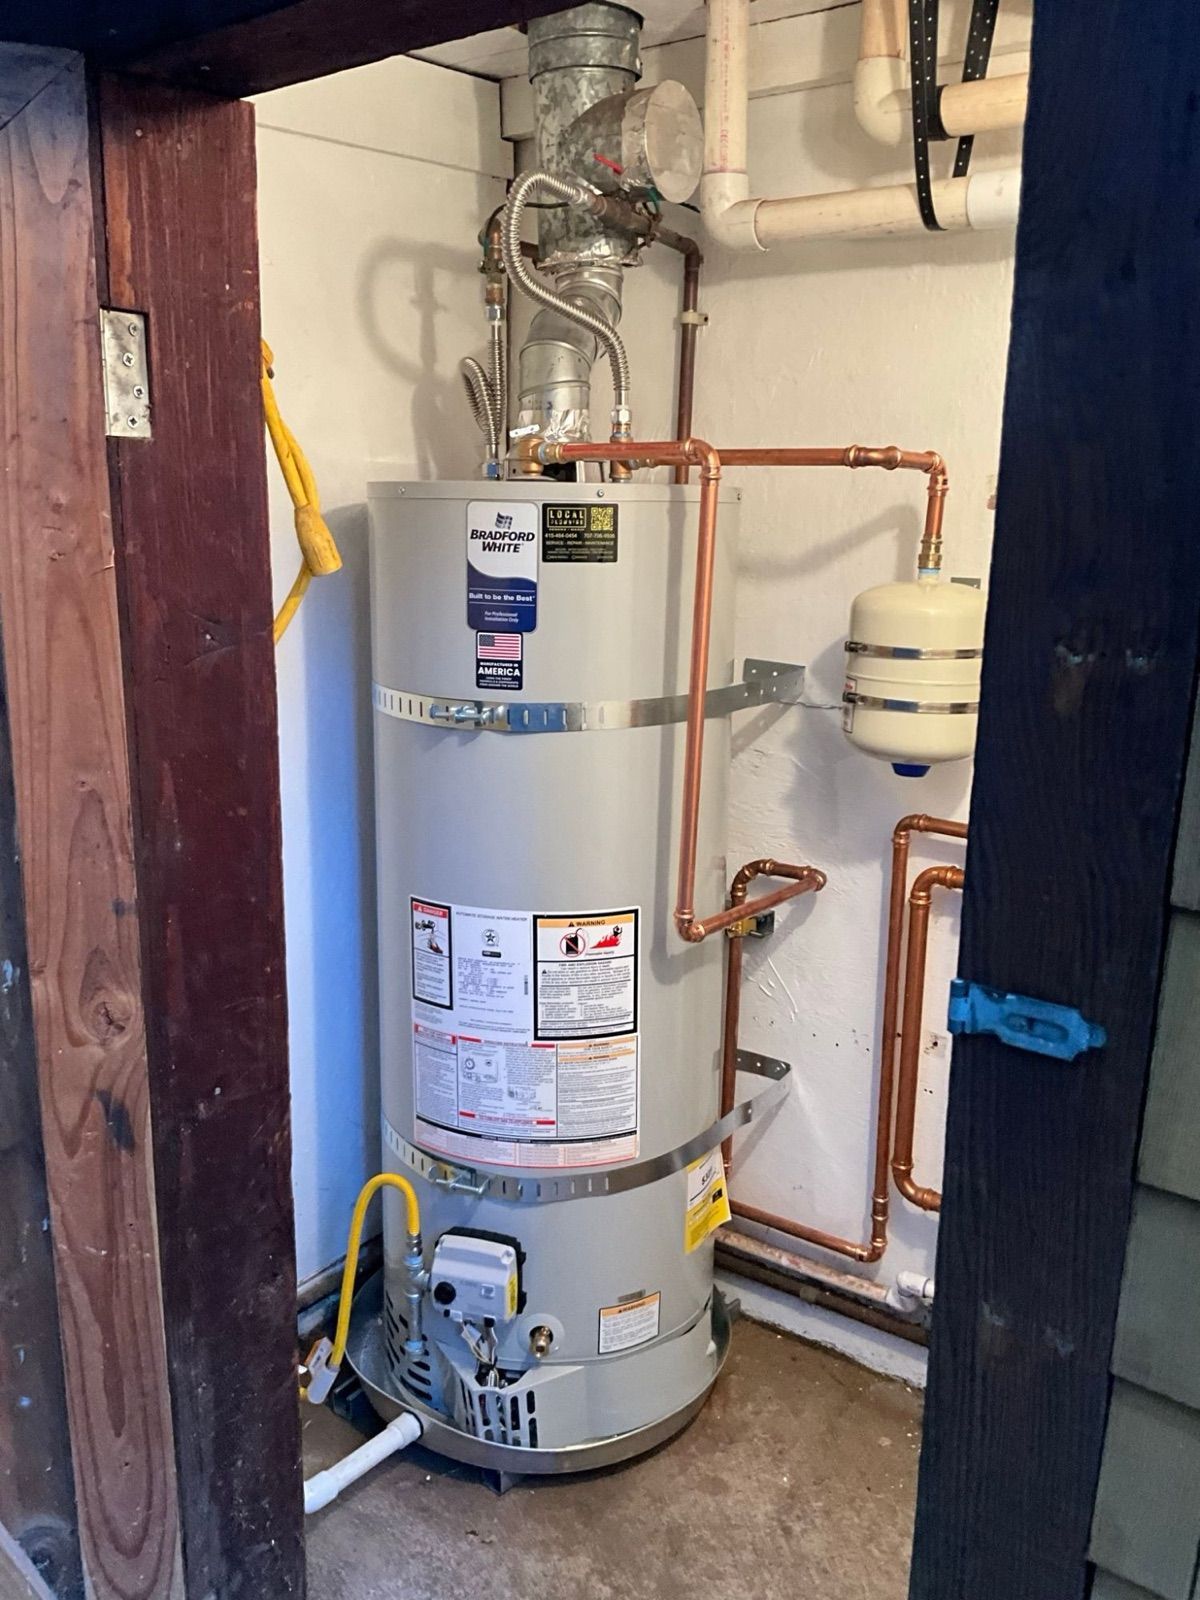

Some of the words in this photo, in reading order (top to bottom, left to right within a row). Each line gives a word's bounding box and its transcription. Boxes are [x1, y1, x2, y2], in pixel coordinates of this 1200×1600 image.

[550, 510, 583, 519] LOCAL
[470, 529, 535, 542] BRADFORD
[482, 541, 521, 553] WHITE
[478, 667, 521, 676] AMERICA
[576, 919, 607, 927] WARNING
